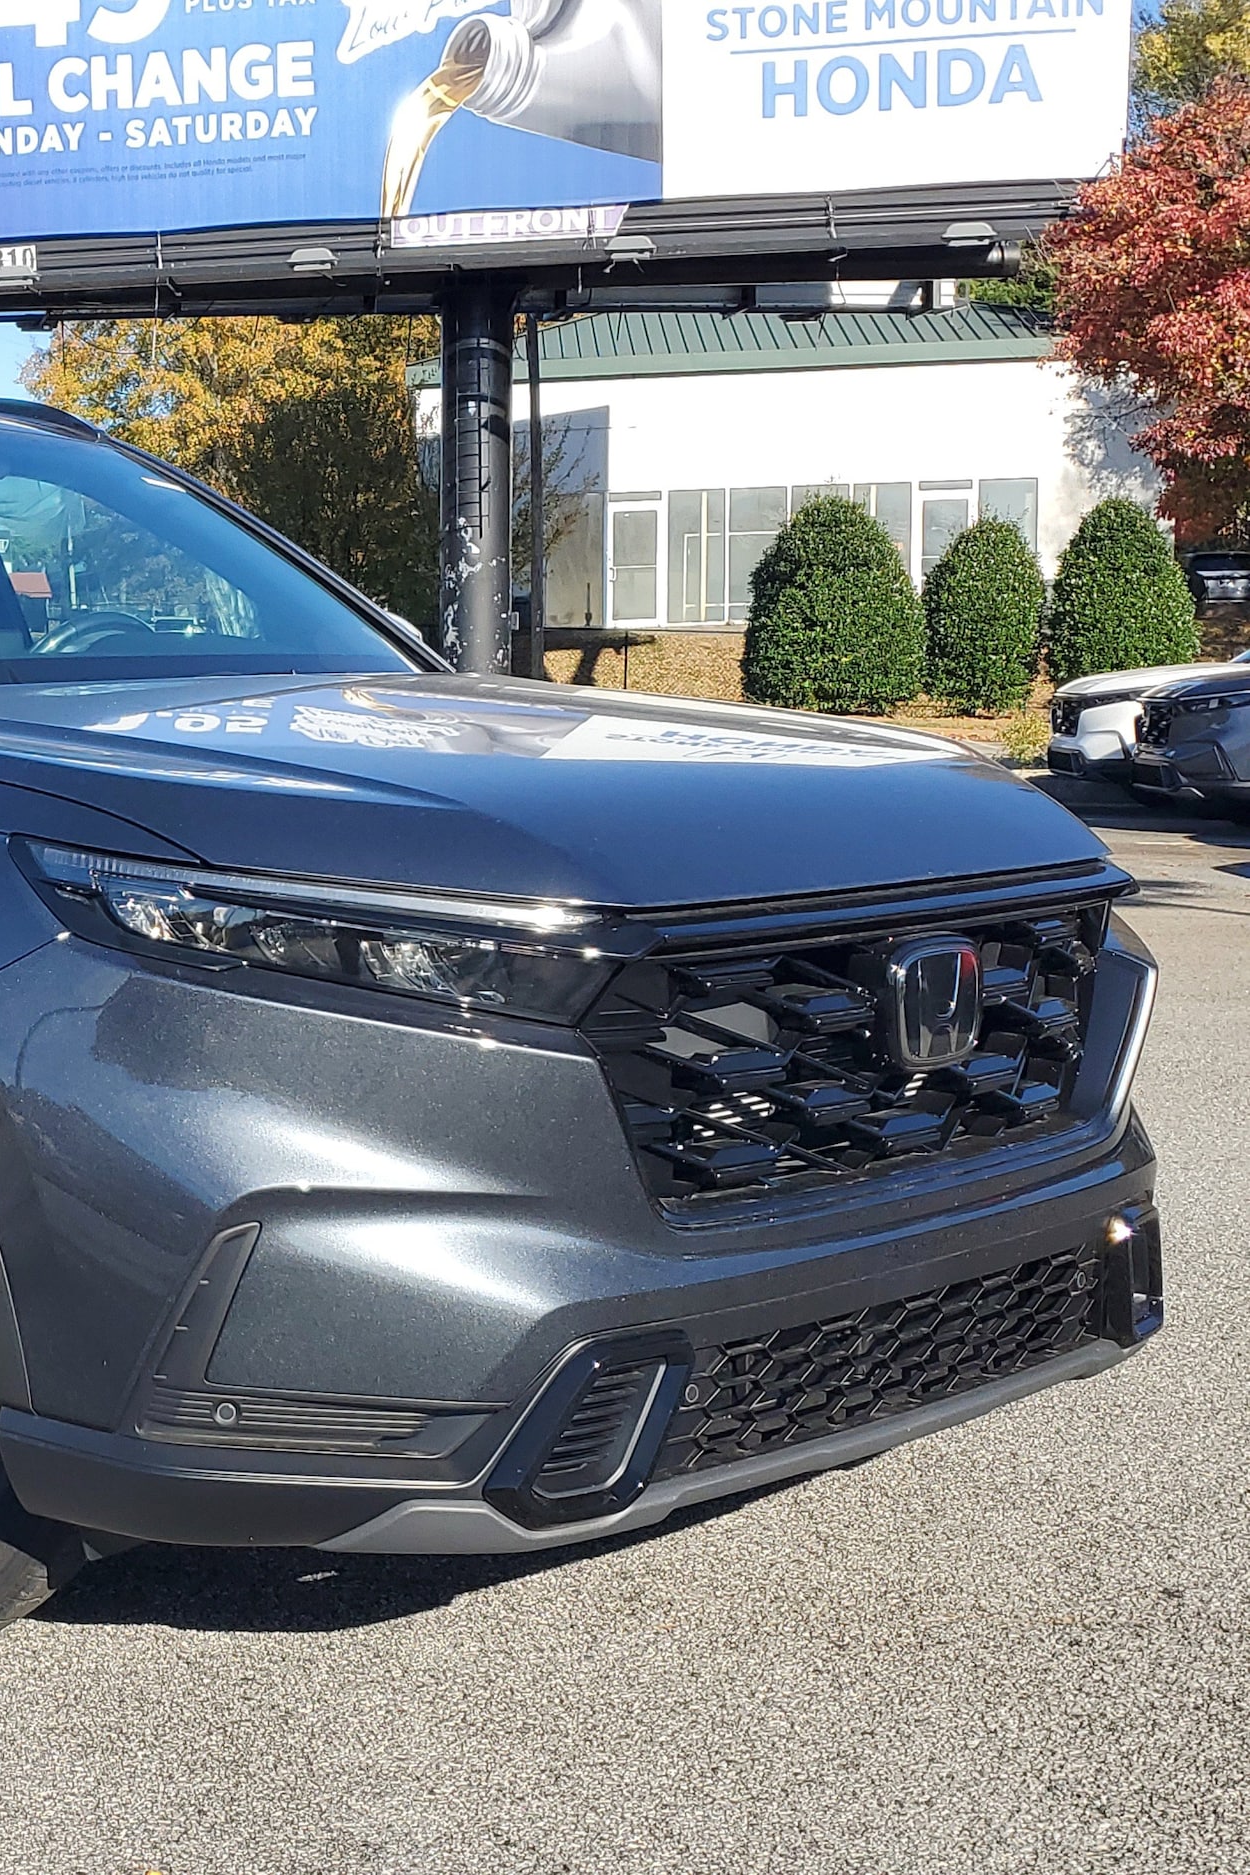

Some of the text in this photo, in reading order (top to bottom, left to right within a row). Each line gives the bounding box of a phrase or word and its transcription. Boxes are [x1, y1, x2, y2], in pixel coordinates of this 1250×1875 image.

[706, 0, 848, 41] STONE
[48, 41, 315, 114] CHANGE
[761, 44, 1043, 119] HONDA
[125, 107, 318, 148] SATURDAY
[51, 168, 68, 176] other
[203, 157, 226, 167] Honda
[253, 155, 266, 163] and
[267, 153, 285, 161] most
[399, 206, 616, 239] OUTFRONT
